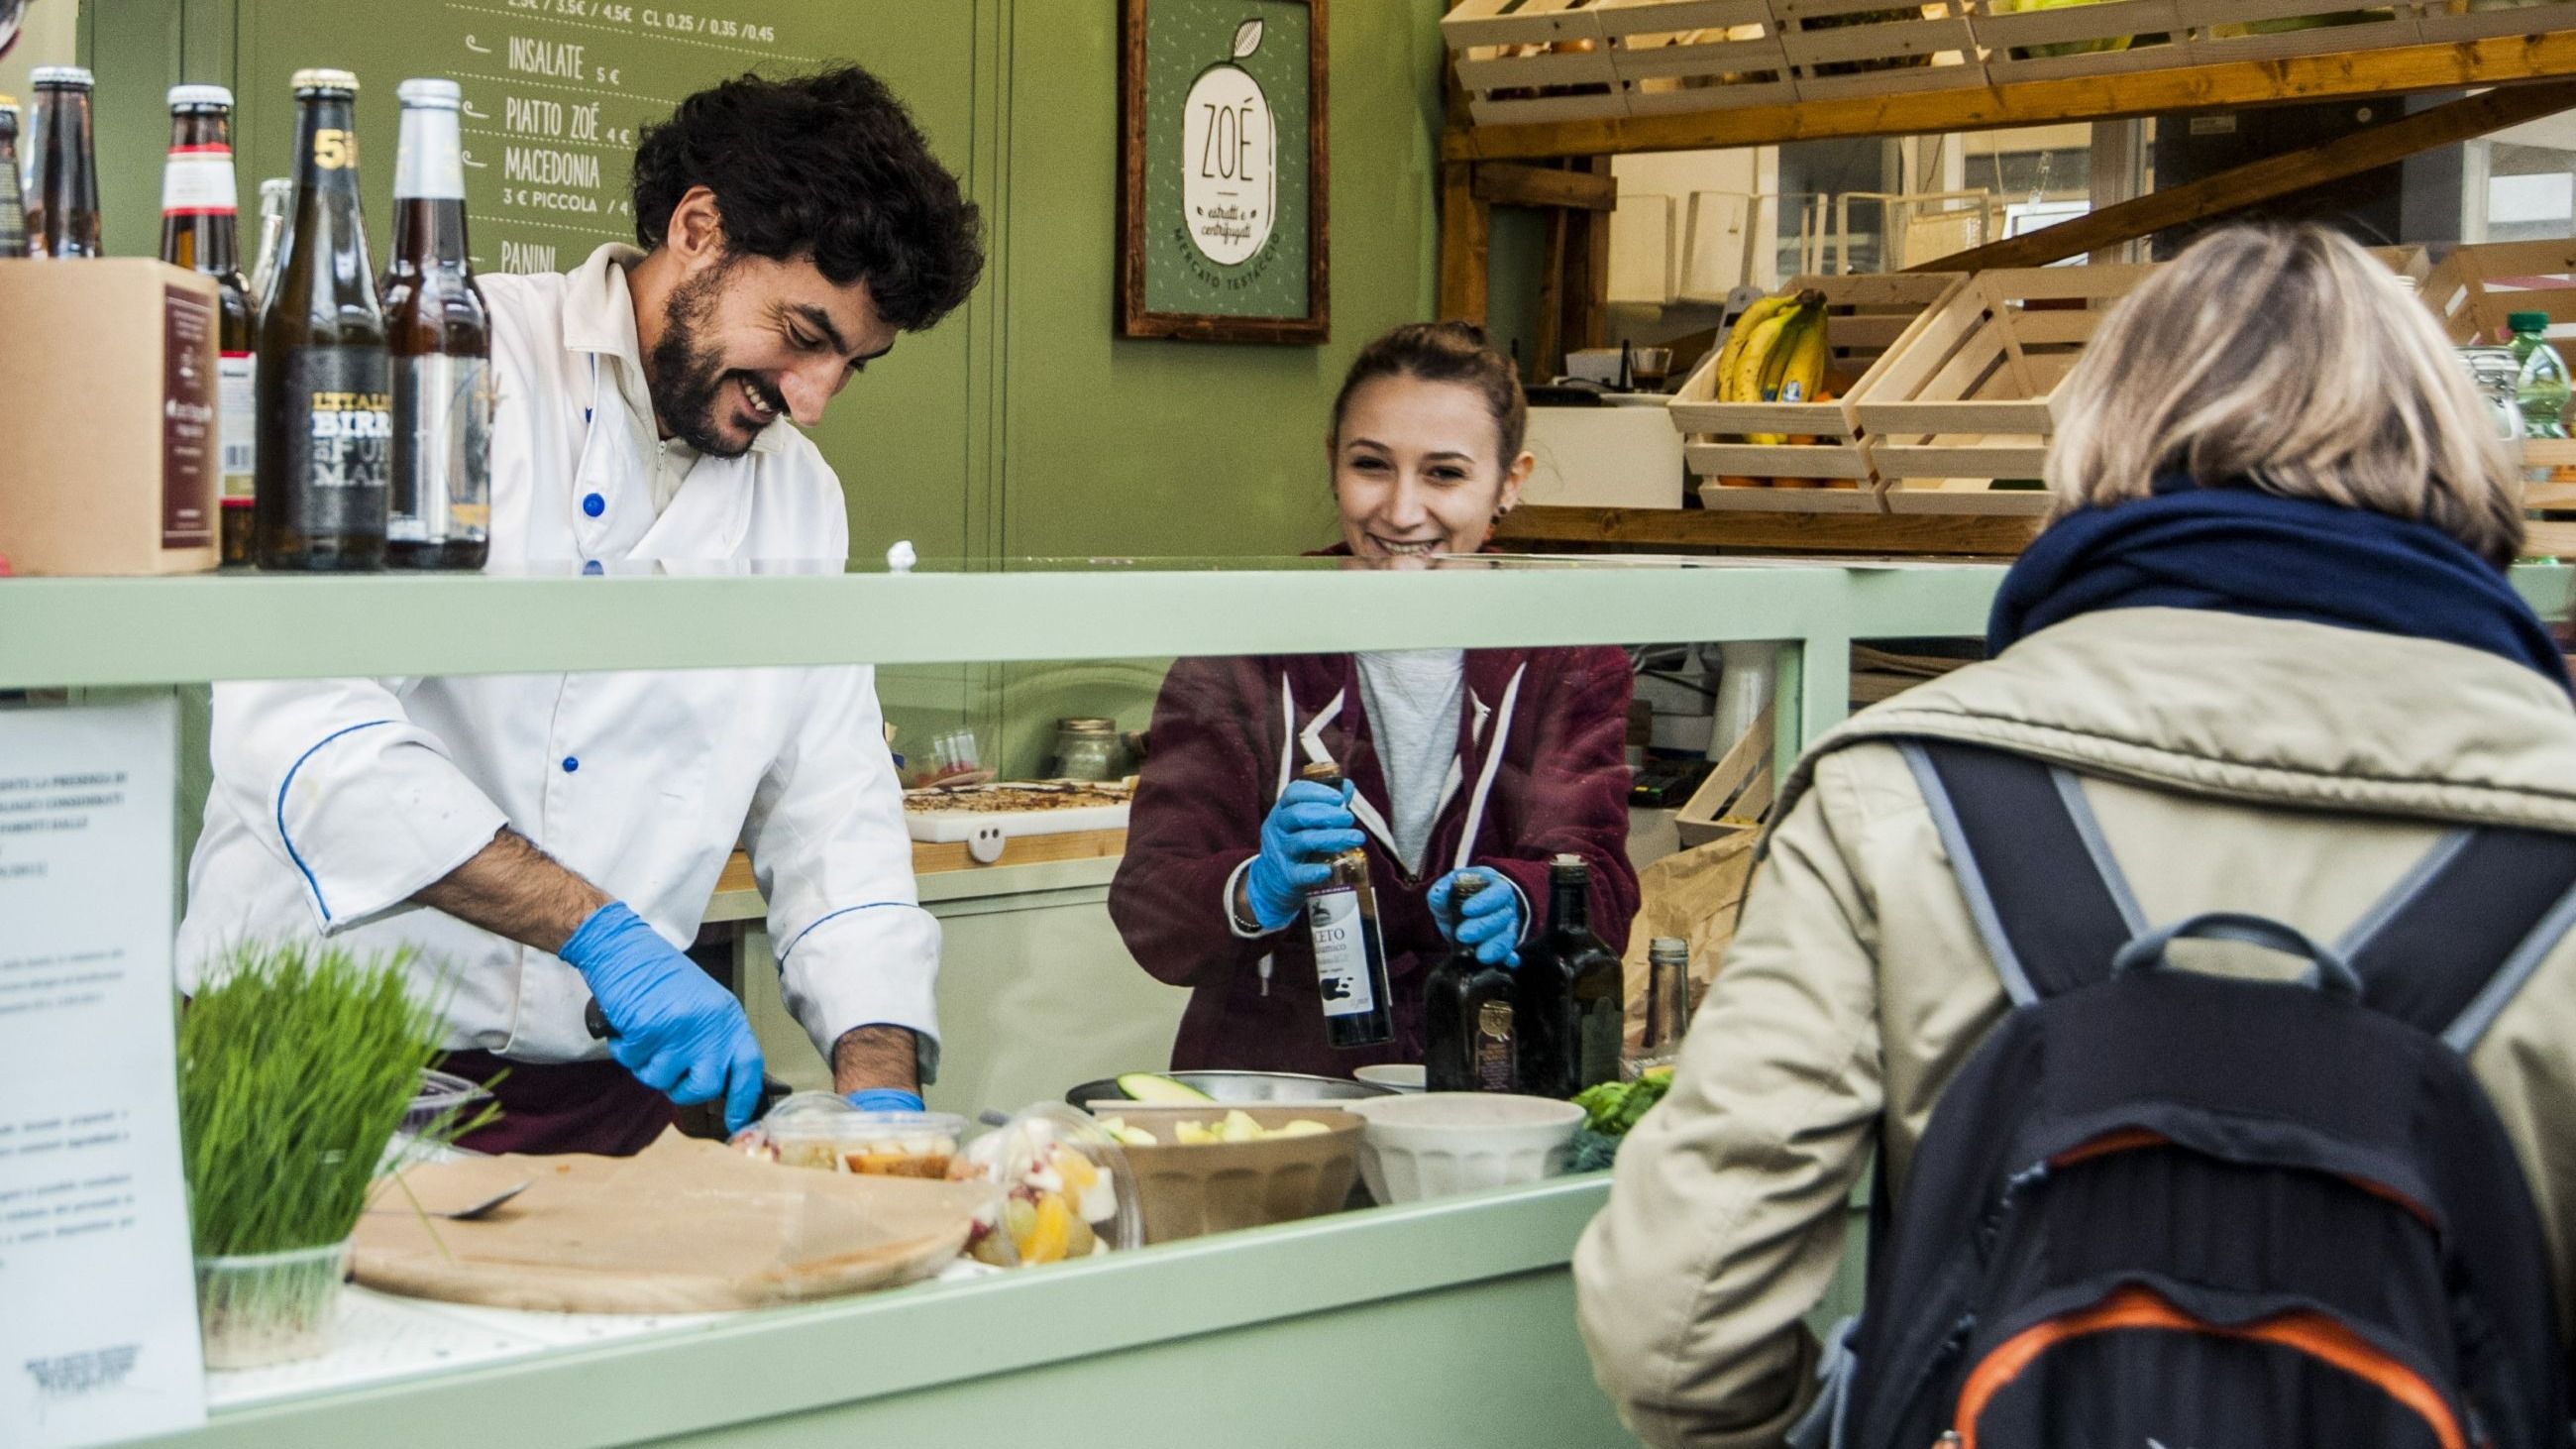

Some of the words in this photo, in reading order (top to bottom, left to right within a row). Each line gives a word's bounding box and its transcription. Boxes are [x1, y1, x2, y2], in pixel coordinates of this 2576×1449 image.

[602, 4, 633, 23] 4.5€
[642, 8, 662, 28] CL
[666, 13, 695, 32] 0.25
[709, 19, 737, 39] 0.35
[508, 35, 586, 80] INSALATE
[596, 66, 605, 83] 5
[609, 68, 620, 86] €
[506, 96, 563, 137] PIATTO
[570, 101, 601, 142] ZOÉ
[606, 127, 616, 144] 4
[619, 128, 631, 146] €
[1202, 96, 1253, 181] ZOÉ
[504, 146, 601, 189] MACEDONIA
[502, 187, 513, 205] 3
[516, 189, 528, 206] €
[532, 191, 597, 213] PICCOLA
[500, 240, 556, 276] PANINI
[1173, 227, 1221, 288] MERCATO
